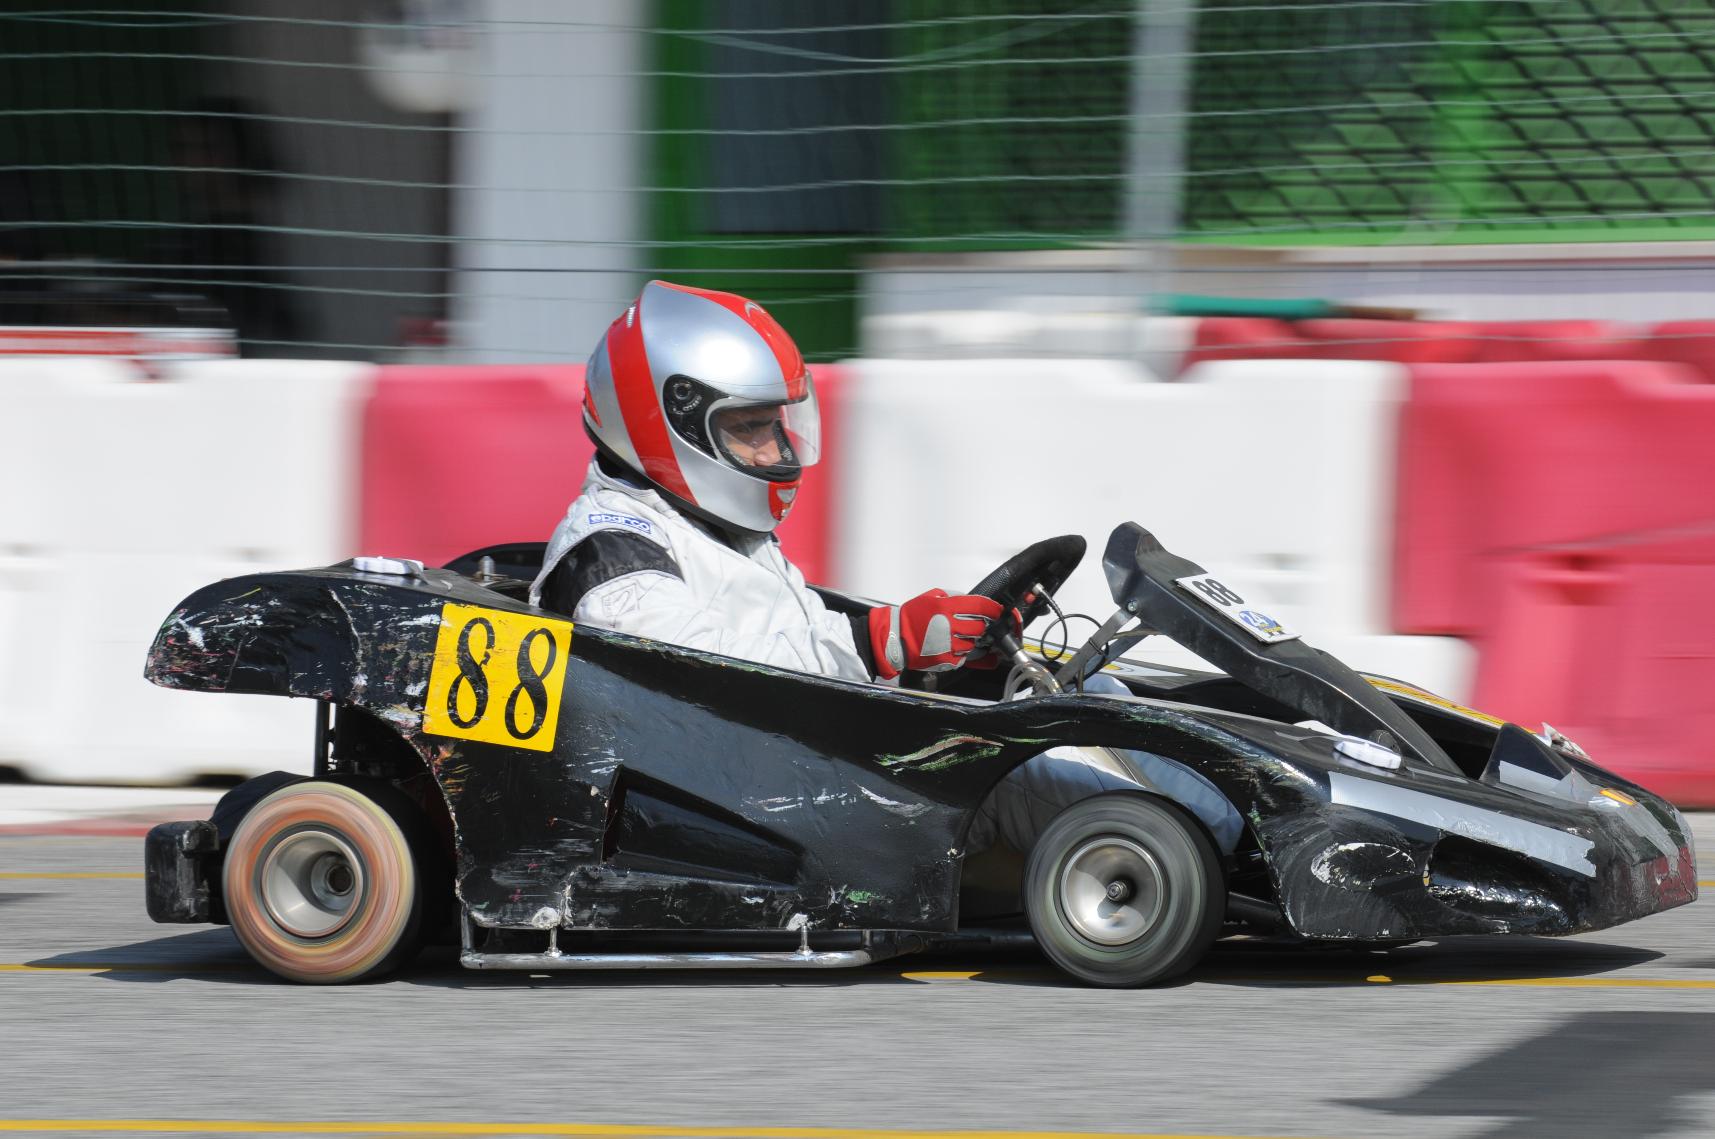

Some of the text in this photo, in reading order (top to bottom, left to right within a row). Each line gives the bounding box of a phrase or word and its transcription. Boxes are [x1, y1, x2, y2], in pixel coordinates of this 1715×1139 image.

[589, 513, 651, 533] sparco
[1192, 578, 1245, 607] 88
[447, 616, 557, 741] 88
